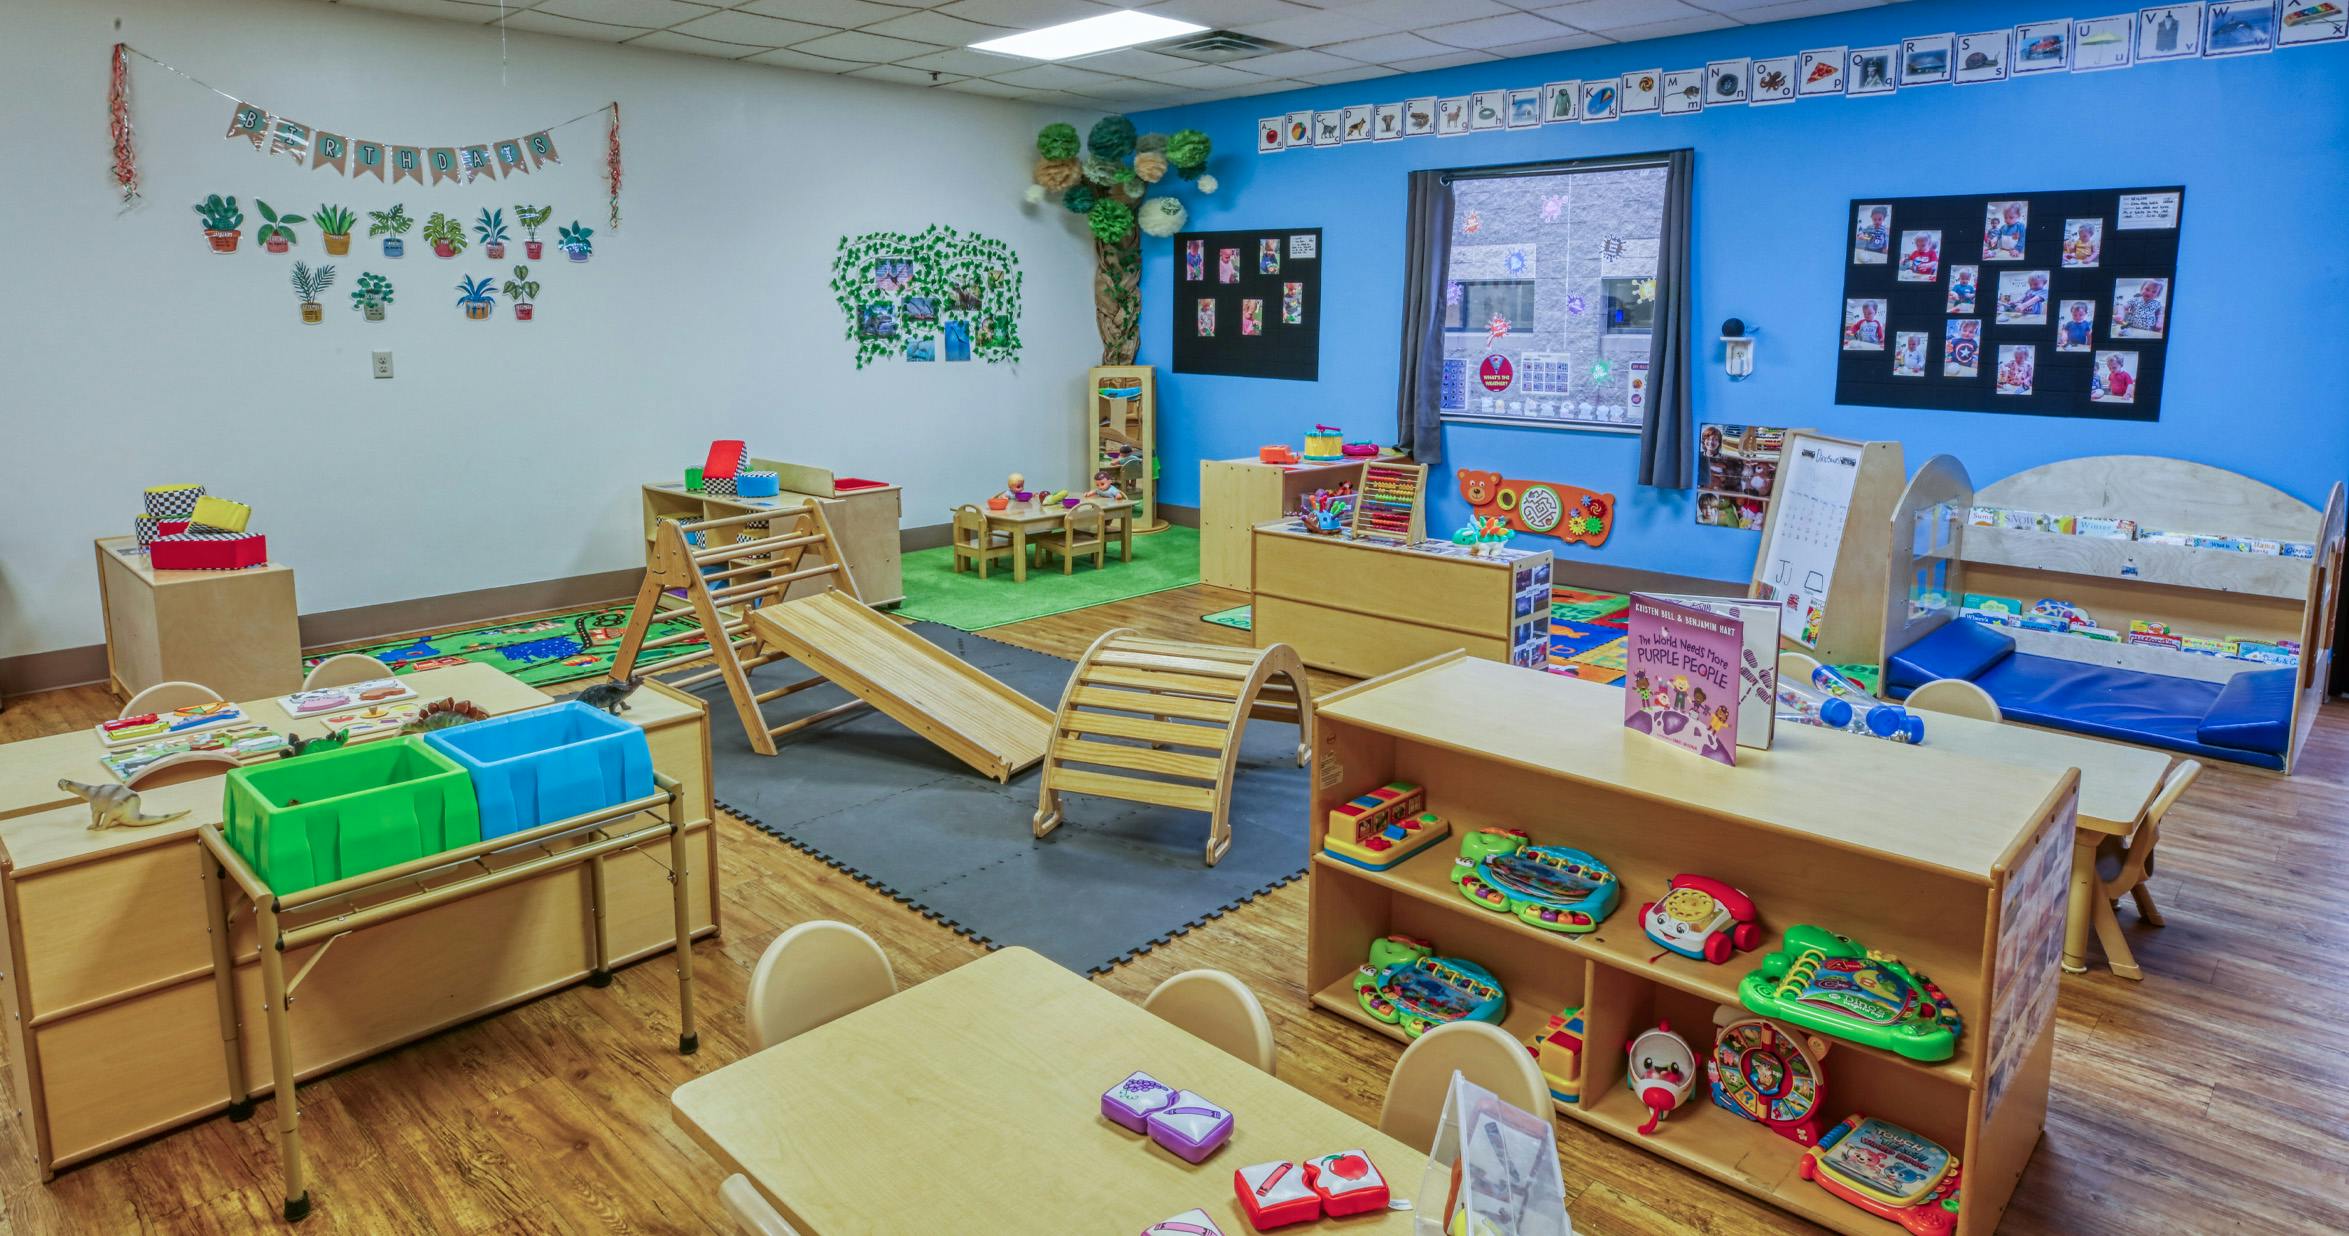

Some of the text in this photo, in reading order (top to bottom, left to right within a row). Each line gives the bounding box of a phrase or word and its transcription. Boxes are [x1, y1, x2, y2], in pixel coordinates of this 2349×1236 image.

[2213, 7, 2229, 19] W
[2145, 13, 2157, 24] V
[2020, 29, 2030, 40] T
[2080, 26, 2090, 36] U
[1906, 42, 1915, 52] R
[1962, 38, 1970, 50] S
[1805, 56, 1812, 66] P
[1853, 55, 1863, 66] Q
[1711, 68, 1719, 78] N
[1757, 65, 1766, 74] O
[1626, 78, 1632, 89] L
[1668, 78, 1677, 86] M
[1550, 88, 1554, 99] J
[1585, 87, 1593, 98] K
[1475, 97, 1483, 105] H
[1375, 106, 1380, 115] E
[1408, 103, 1413, 112] F
[1441, 102, 1448, 112] G
[1288, 115, 1293, 123] B
[1317, 113, 1322, 123] C
[1346, 111, 1351, 119] D
[1636, 603, 1736, 637] KRISTEN BELL & BENJAMIN HART
[1639, 634, 1728, 670] The World Needs More
[1638, 648, 1728, 689] PURPLE PEOPLE
[1873, 1127, 1925, 1152] TOUCH
